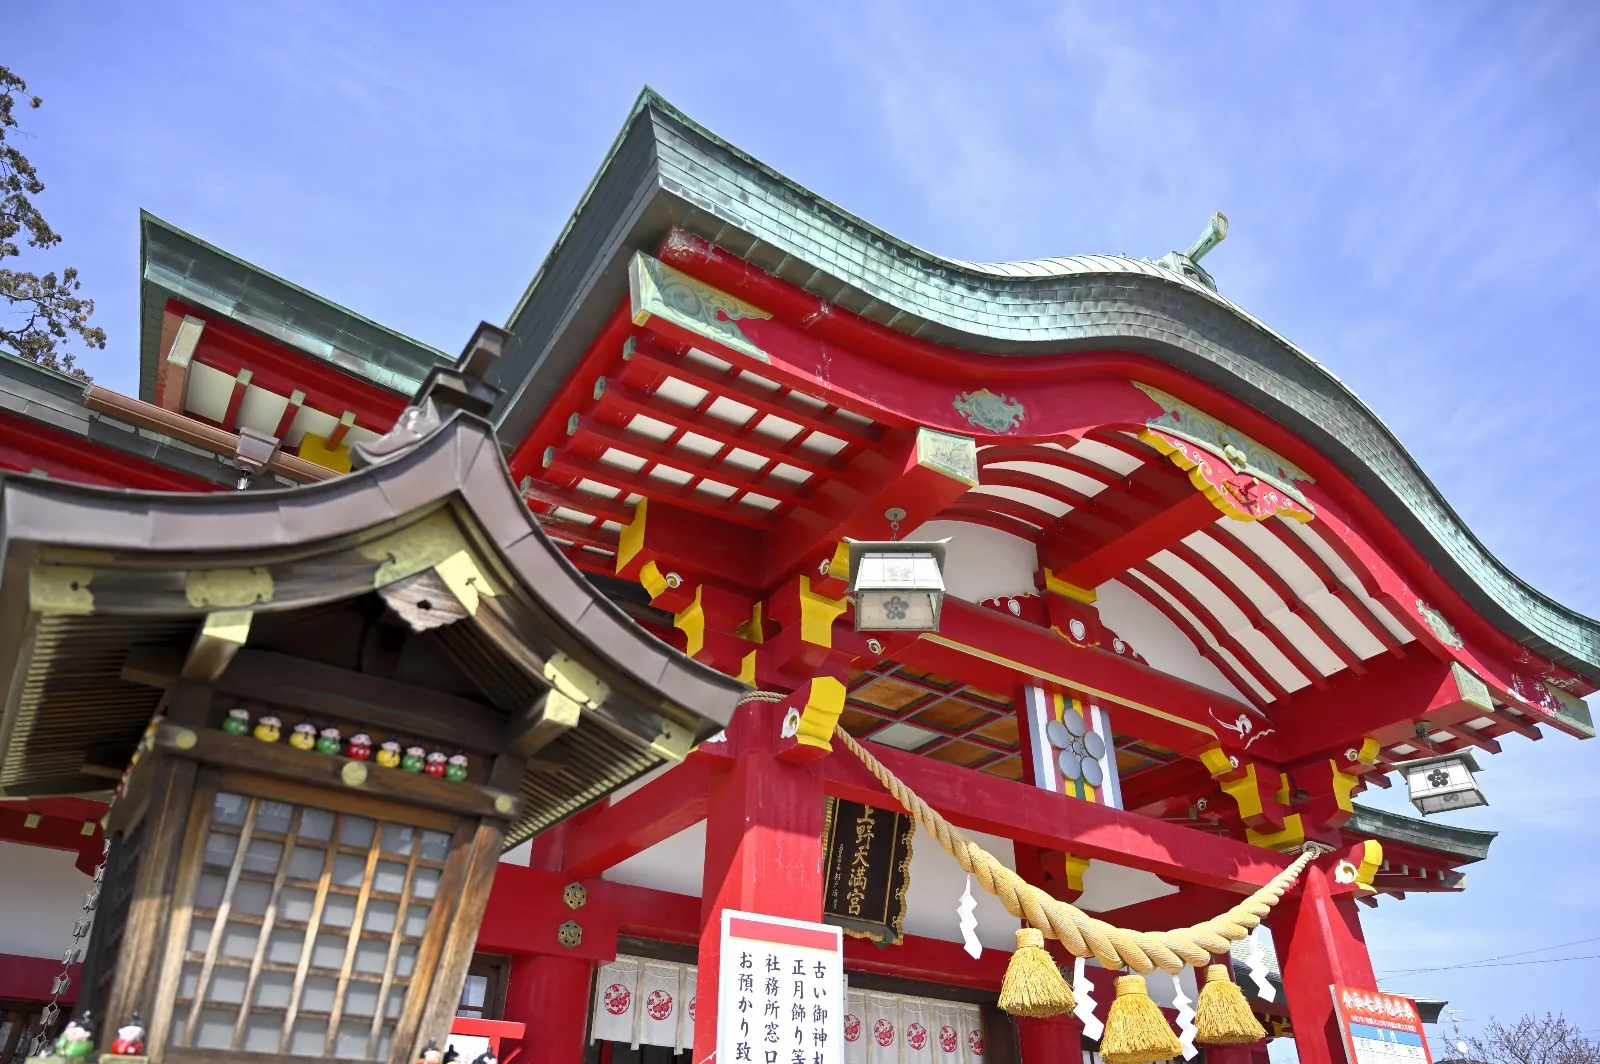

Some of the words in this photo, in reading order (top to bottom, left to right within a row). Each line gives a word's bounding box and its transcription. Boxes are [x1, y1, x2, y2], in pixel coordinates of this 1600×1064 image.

[846, 805, 875, 916] 上野天満宮
[735, 951, 754, 1062] お預かり致
[764, 953, 781, 1064] 社務所窓口
